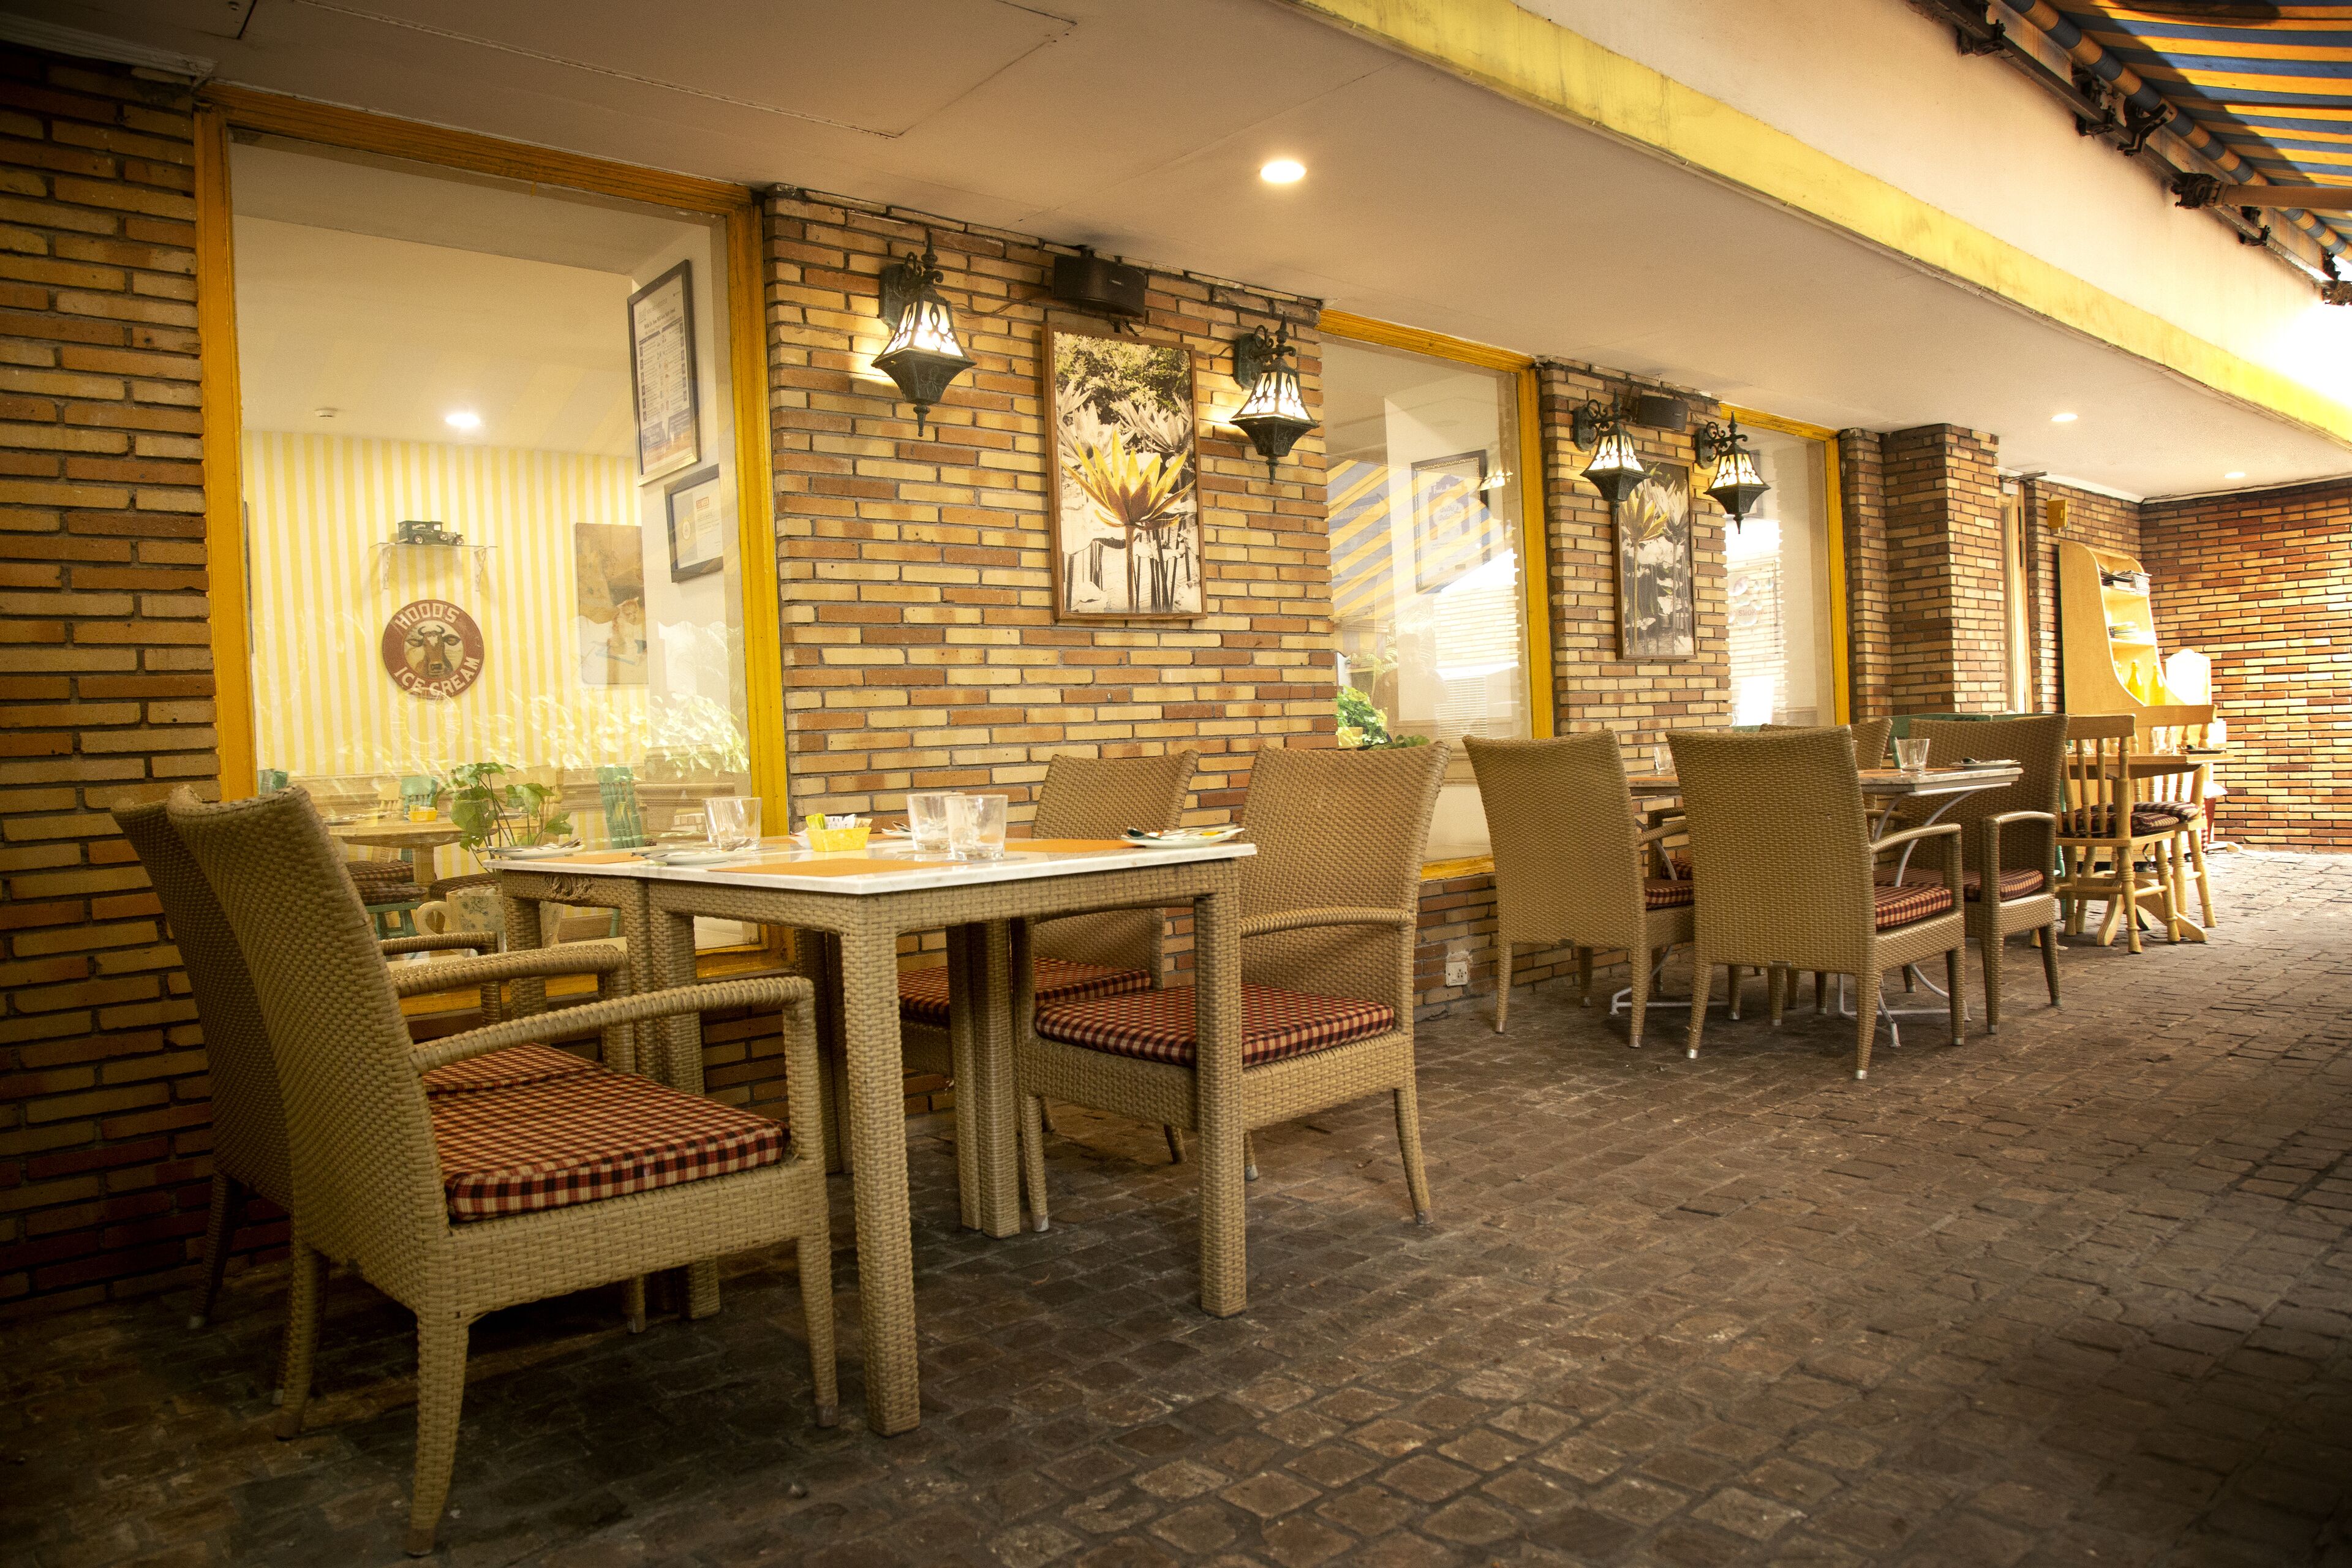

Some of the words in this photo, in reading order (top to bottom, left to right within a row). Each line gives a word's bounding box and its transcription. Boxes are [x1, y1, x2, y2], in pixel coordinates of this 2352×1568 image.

[394, 603, 459, 630] HOOD'S
[394, 666, 426, 695] ICE
[429, 657, 480, 696] CREAM
